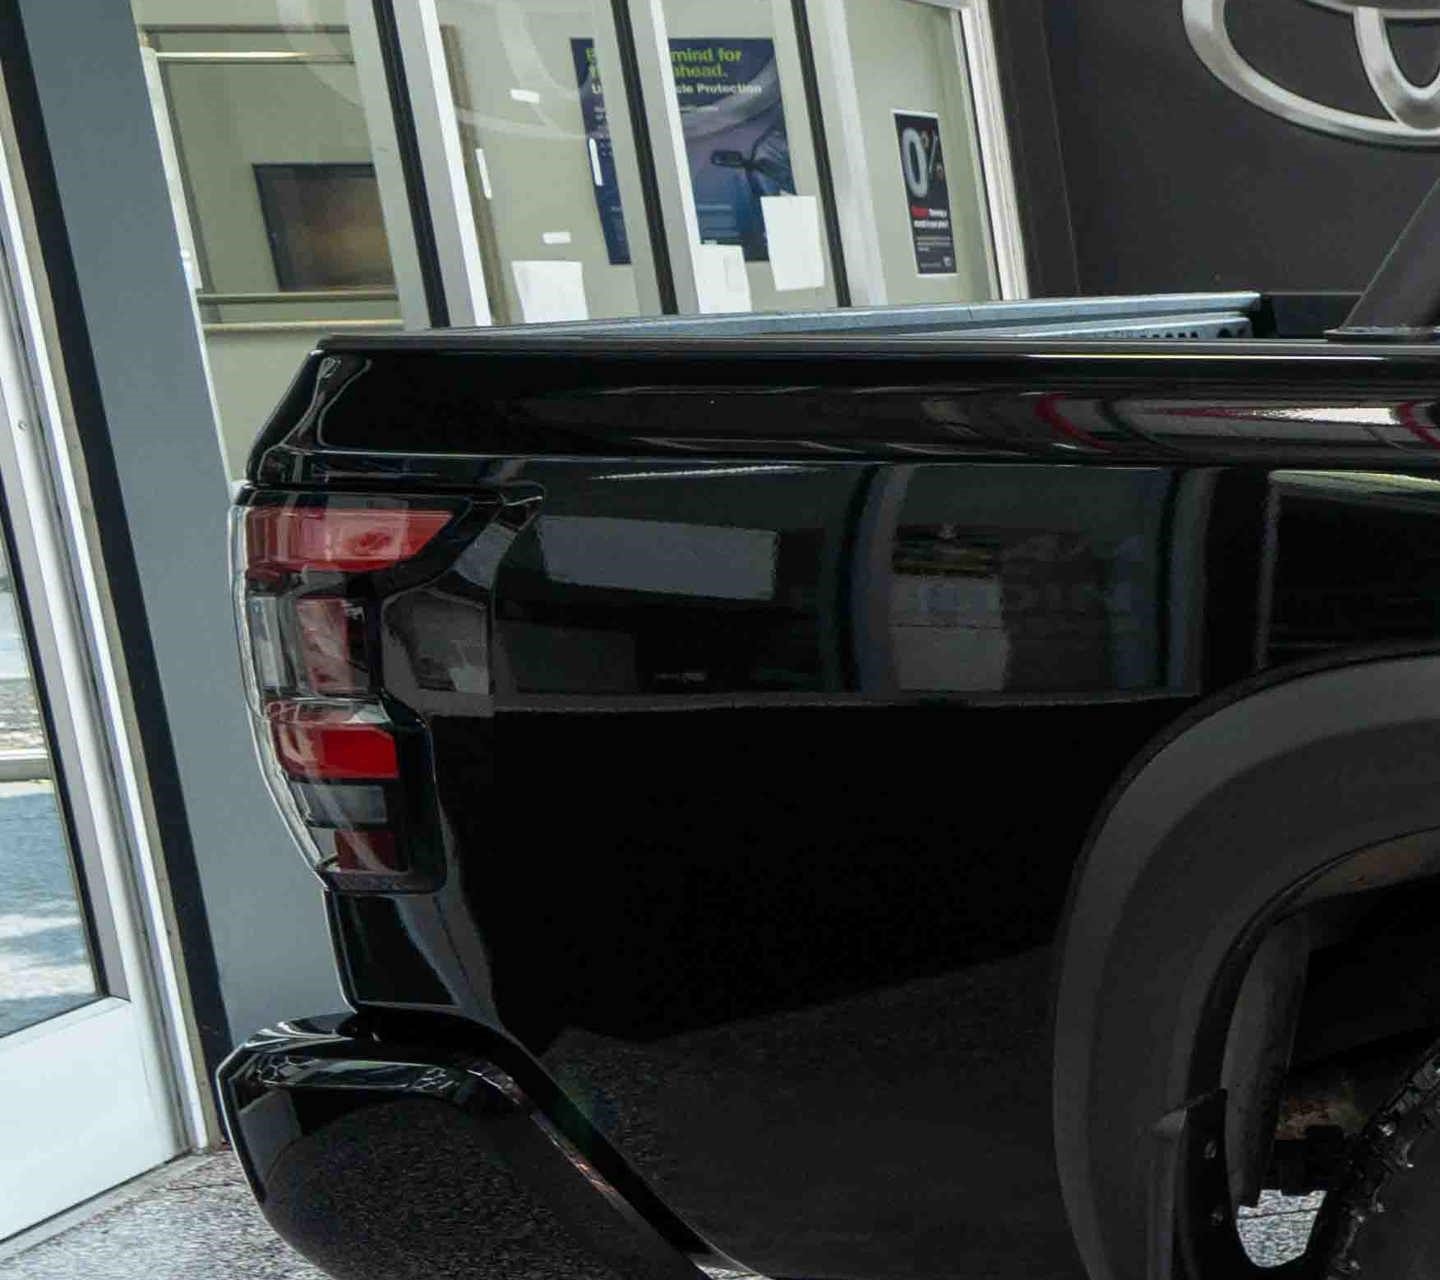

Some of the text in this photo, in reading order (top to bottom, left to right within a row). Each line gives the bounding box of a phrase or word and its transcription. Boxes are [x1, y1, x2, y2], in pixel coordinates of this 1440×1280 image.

[671, 48, 742, 62] mind for
[696, 83, 763, 95] Protection
[902, 127, 944, 197] 0%
